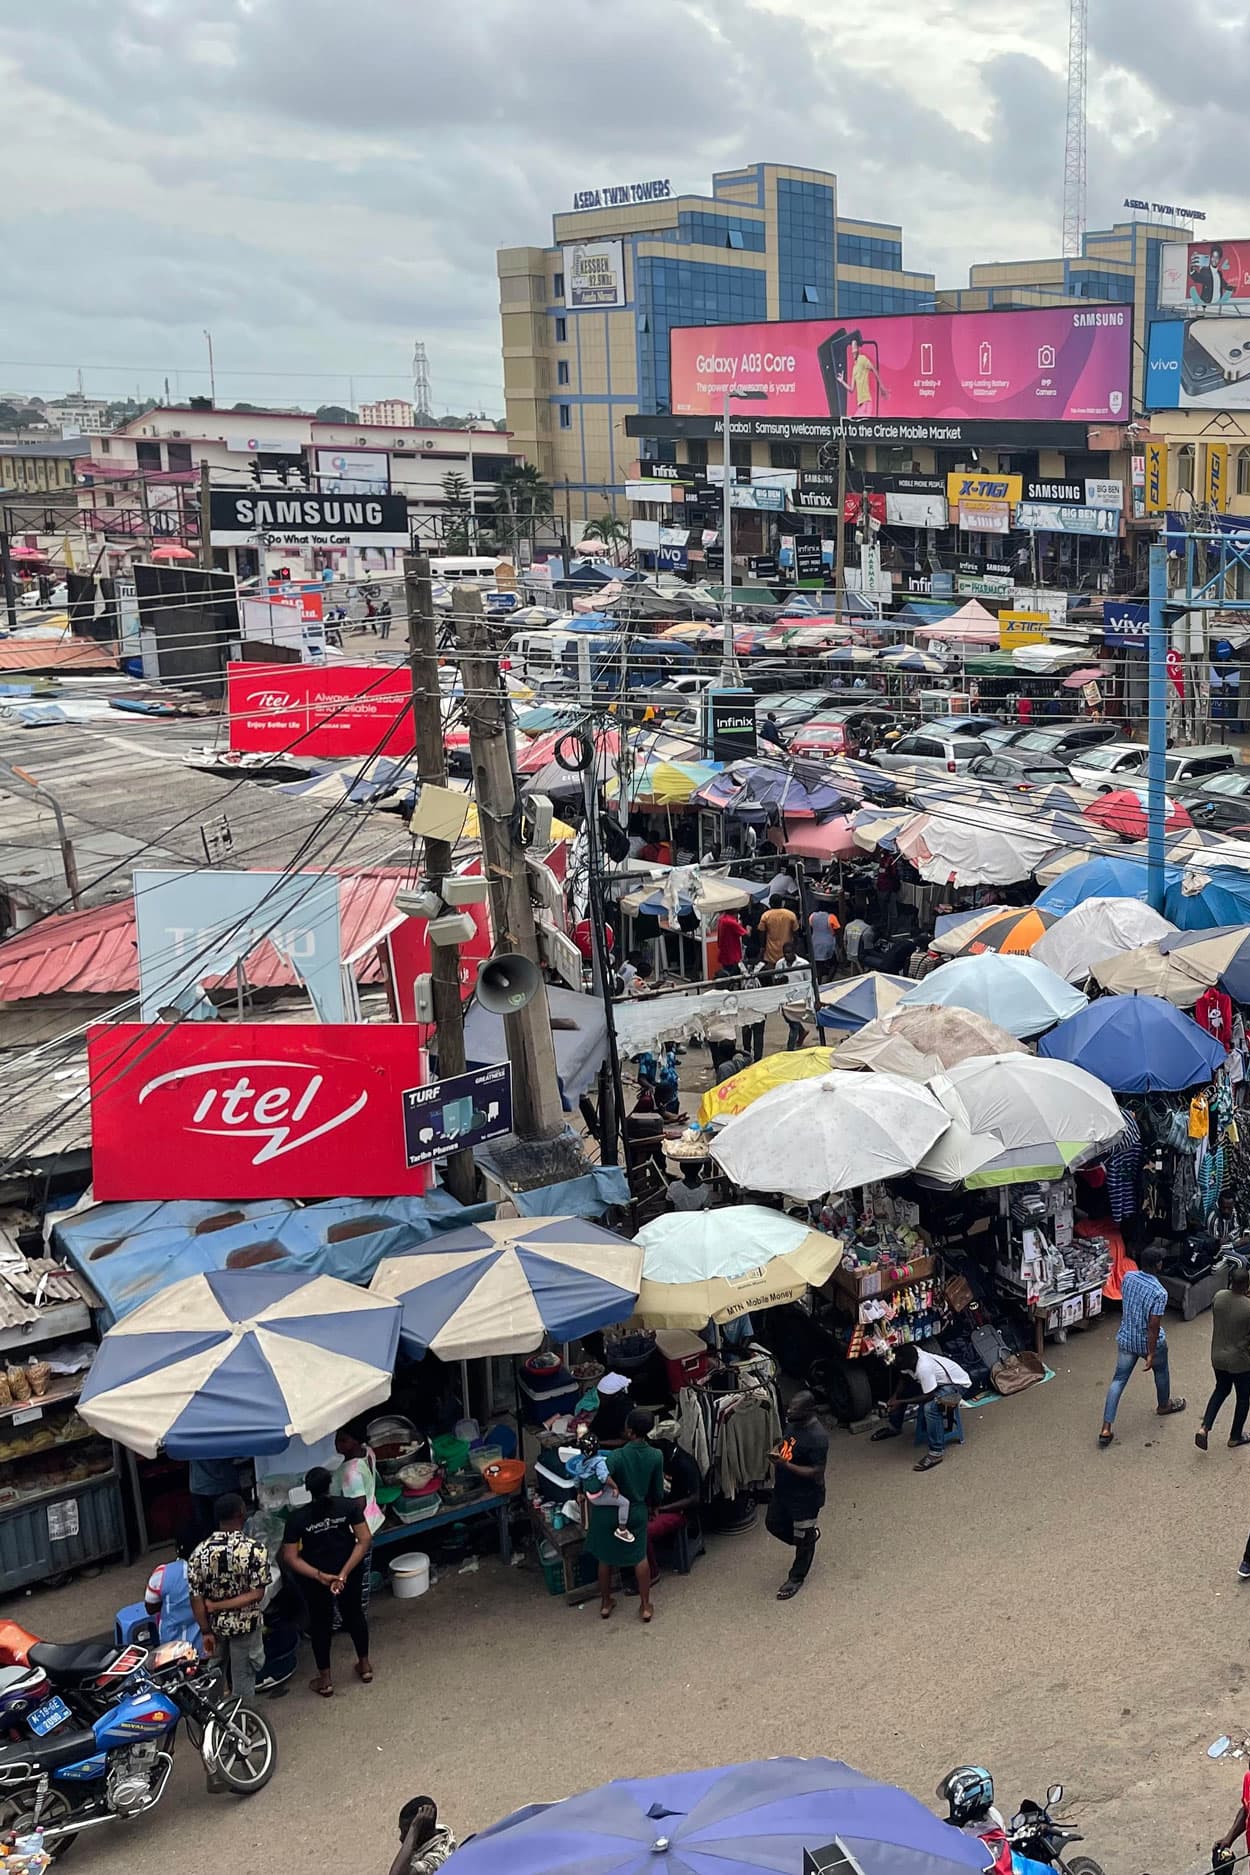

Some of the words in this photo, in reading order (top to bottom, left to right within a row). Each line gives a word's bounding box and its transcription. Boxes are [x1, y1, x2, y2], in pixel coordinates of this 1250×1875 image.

[573, 190, 602, 210] ASEDA
[602, 186, 631, 206] TWIN
[631, 180, 670, 203] TOWERS
[1124, 199, 1150, 211] ASEDA
[1152, 203, 1175, 216] TWIN
[1176, 208, 1207, 221] TOWERS
[1073, 312, 1124, 327] SAMSUNG
[696, 355, 738, 378] Galaxy
[740, 353, 762, 372] A03
[763, 353, 796, 372] Core
[1150, 358, 1178, 370] vivo
[697, 382, 708, 393] The
[708, 384, 730, 394] power
[1035, 388, 1057, 396] Camera
[755, 422, 790, 437] Samsung
[790, 424, 831, 437] welcomes
[848, 425, 858, 436] to
[858, 425, 872, 437] the
[874, 425, 898, 438] Circle
[899, 425, 929, 439] Mobile
[929, 426, 962, 440] Market
[652, 464, 679, 479] Infinix
[804, 474, 833, 484] SAMSUNG
[1150, 446, 1160, 505] X-TIGI
[898, 479, 914, 488] MOBILE
[914, 480, 928, 488] PHONE
[928, 480, 945, 489] PEOPLE
[959, 479, 1009, 499] X-TIGI
[1028, 483, 1081, 500] SAMSUNG
[1096, 484, 1106, 493] BIG
[1106, 484, 1120, 494] BEN
[799, 491, 833, 507] Infinix
[236, 499, 383, 526] SAMSUNG
[1061, 507, 1078, 518] BIG
[1078, 508, 1098, 519] BEN
[268, 534, 281, 544] Do
[283, 534, 309, 544] What
[311, 534, 328, 544] You
[330, 534, 351, 544] Can't
[258, 694, 290, 707] itel
[247, 721, 266, 729] Enjoy
[267, 721, 288, 729] Better
[288, 721, 300, 729] Life
[716, 714, 754, 728] Infinix
[475, 1069, 506, 1085] GREATNESS
[408, 1086, 441, 1106] TURF
[433, 1142, 459, 1156] Phones
[726, 1302, 745, 1316] MTN
[745, 1294, 769, 1307] Mobile
[769, 1287, 793, 1302] Money
